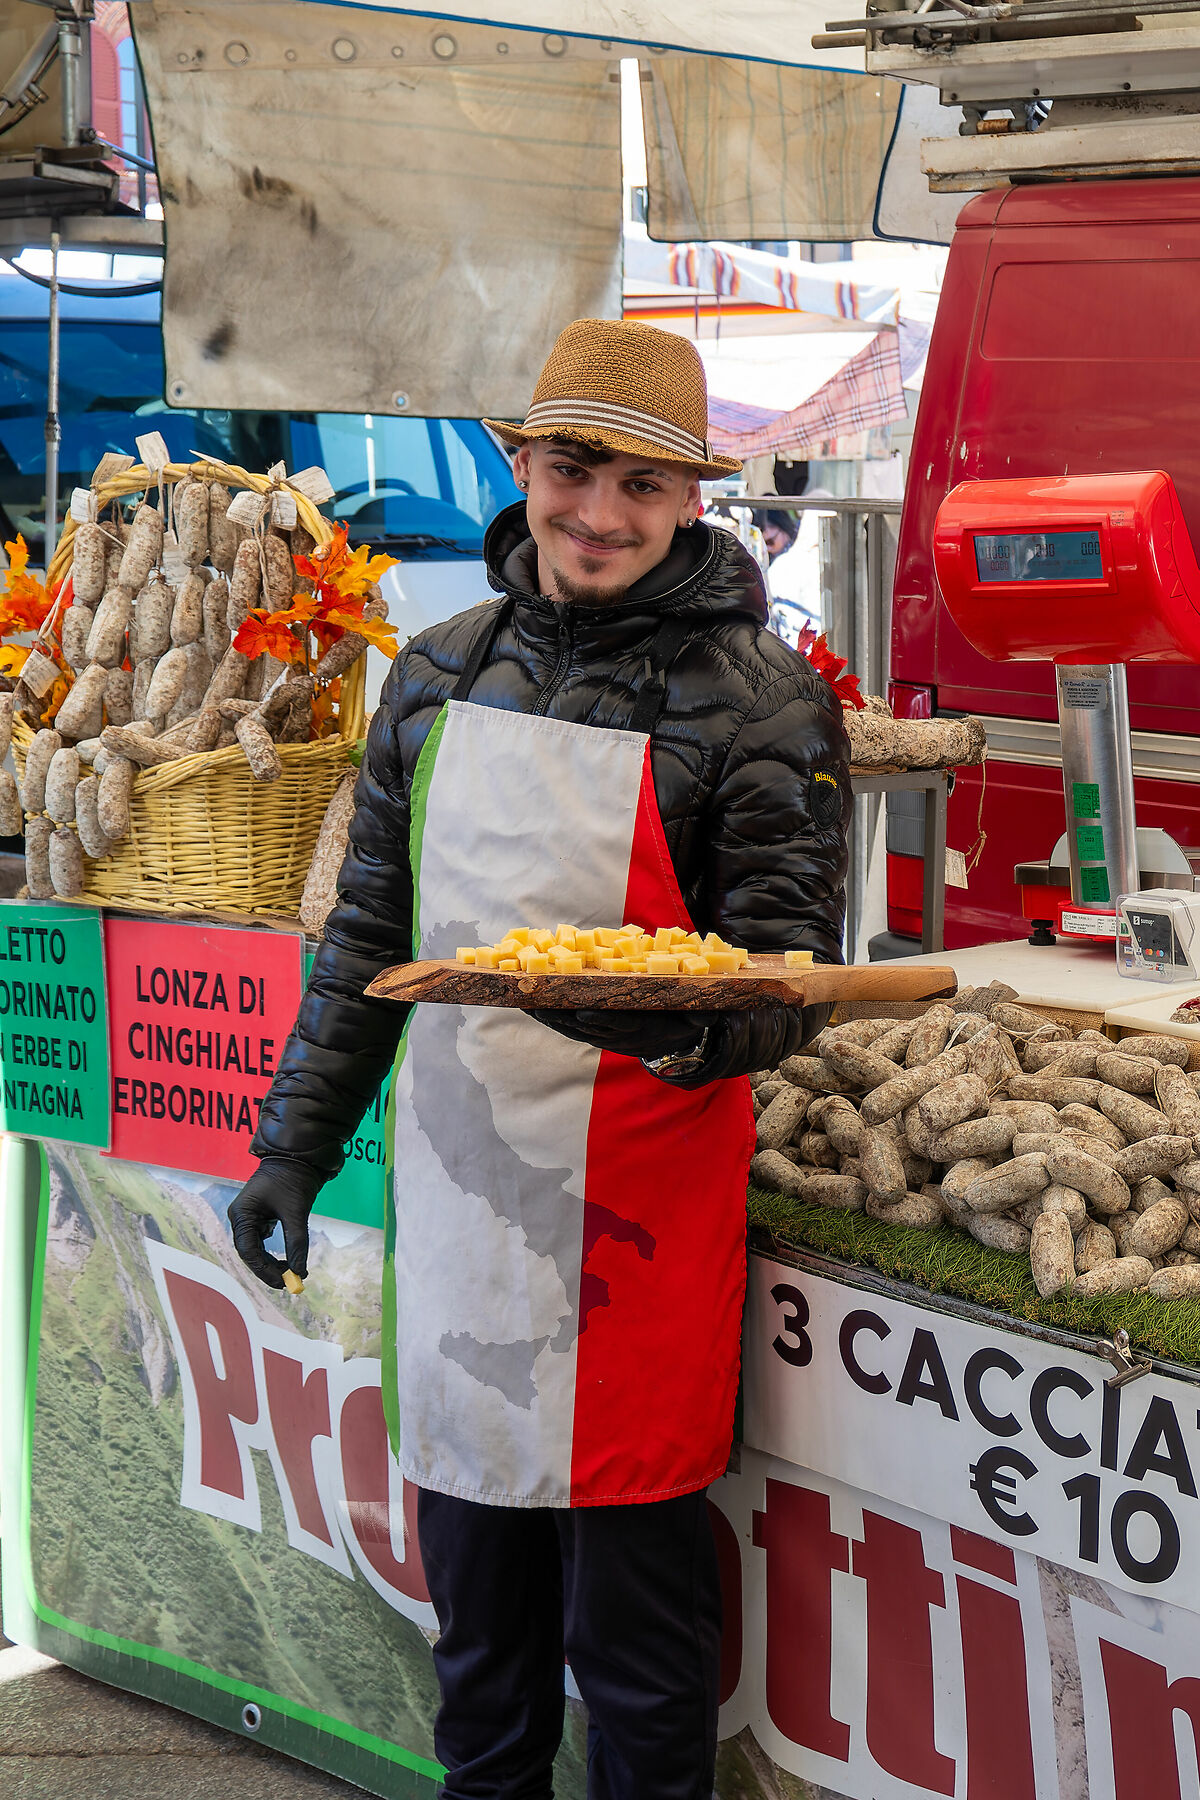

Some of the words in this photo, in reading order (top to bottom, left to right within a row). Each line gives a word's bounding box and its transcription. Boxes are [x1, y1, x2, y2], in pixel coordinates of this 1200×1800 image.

[136, 965, 229, 1012] LONZA
[239, 975, 265, 1016] DI
[12, 1034, 62, 1069] ERBE
[68, 1040, 87, 1073] DI
[128, 1022, 275, 1078] CINGHIALE
[769, 1283, 814, 1368] 3
[969, 1446, 1039, 1537] €
[1062, 1473, 1181, 1584] 10
